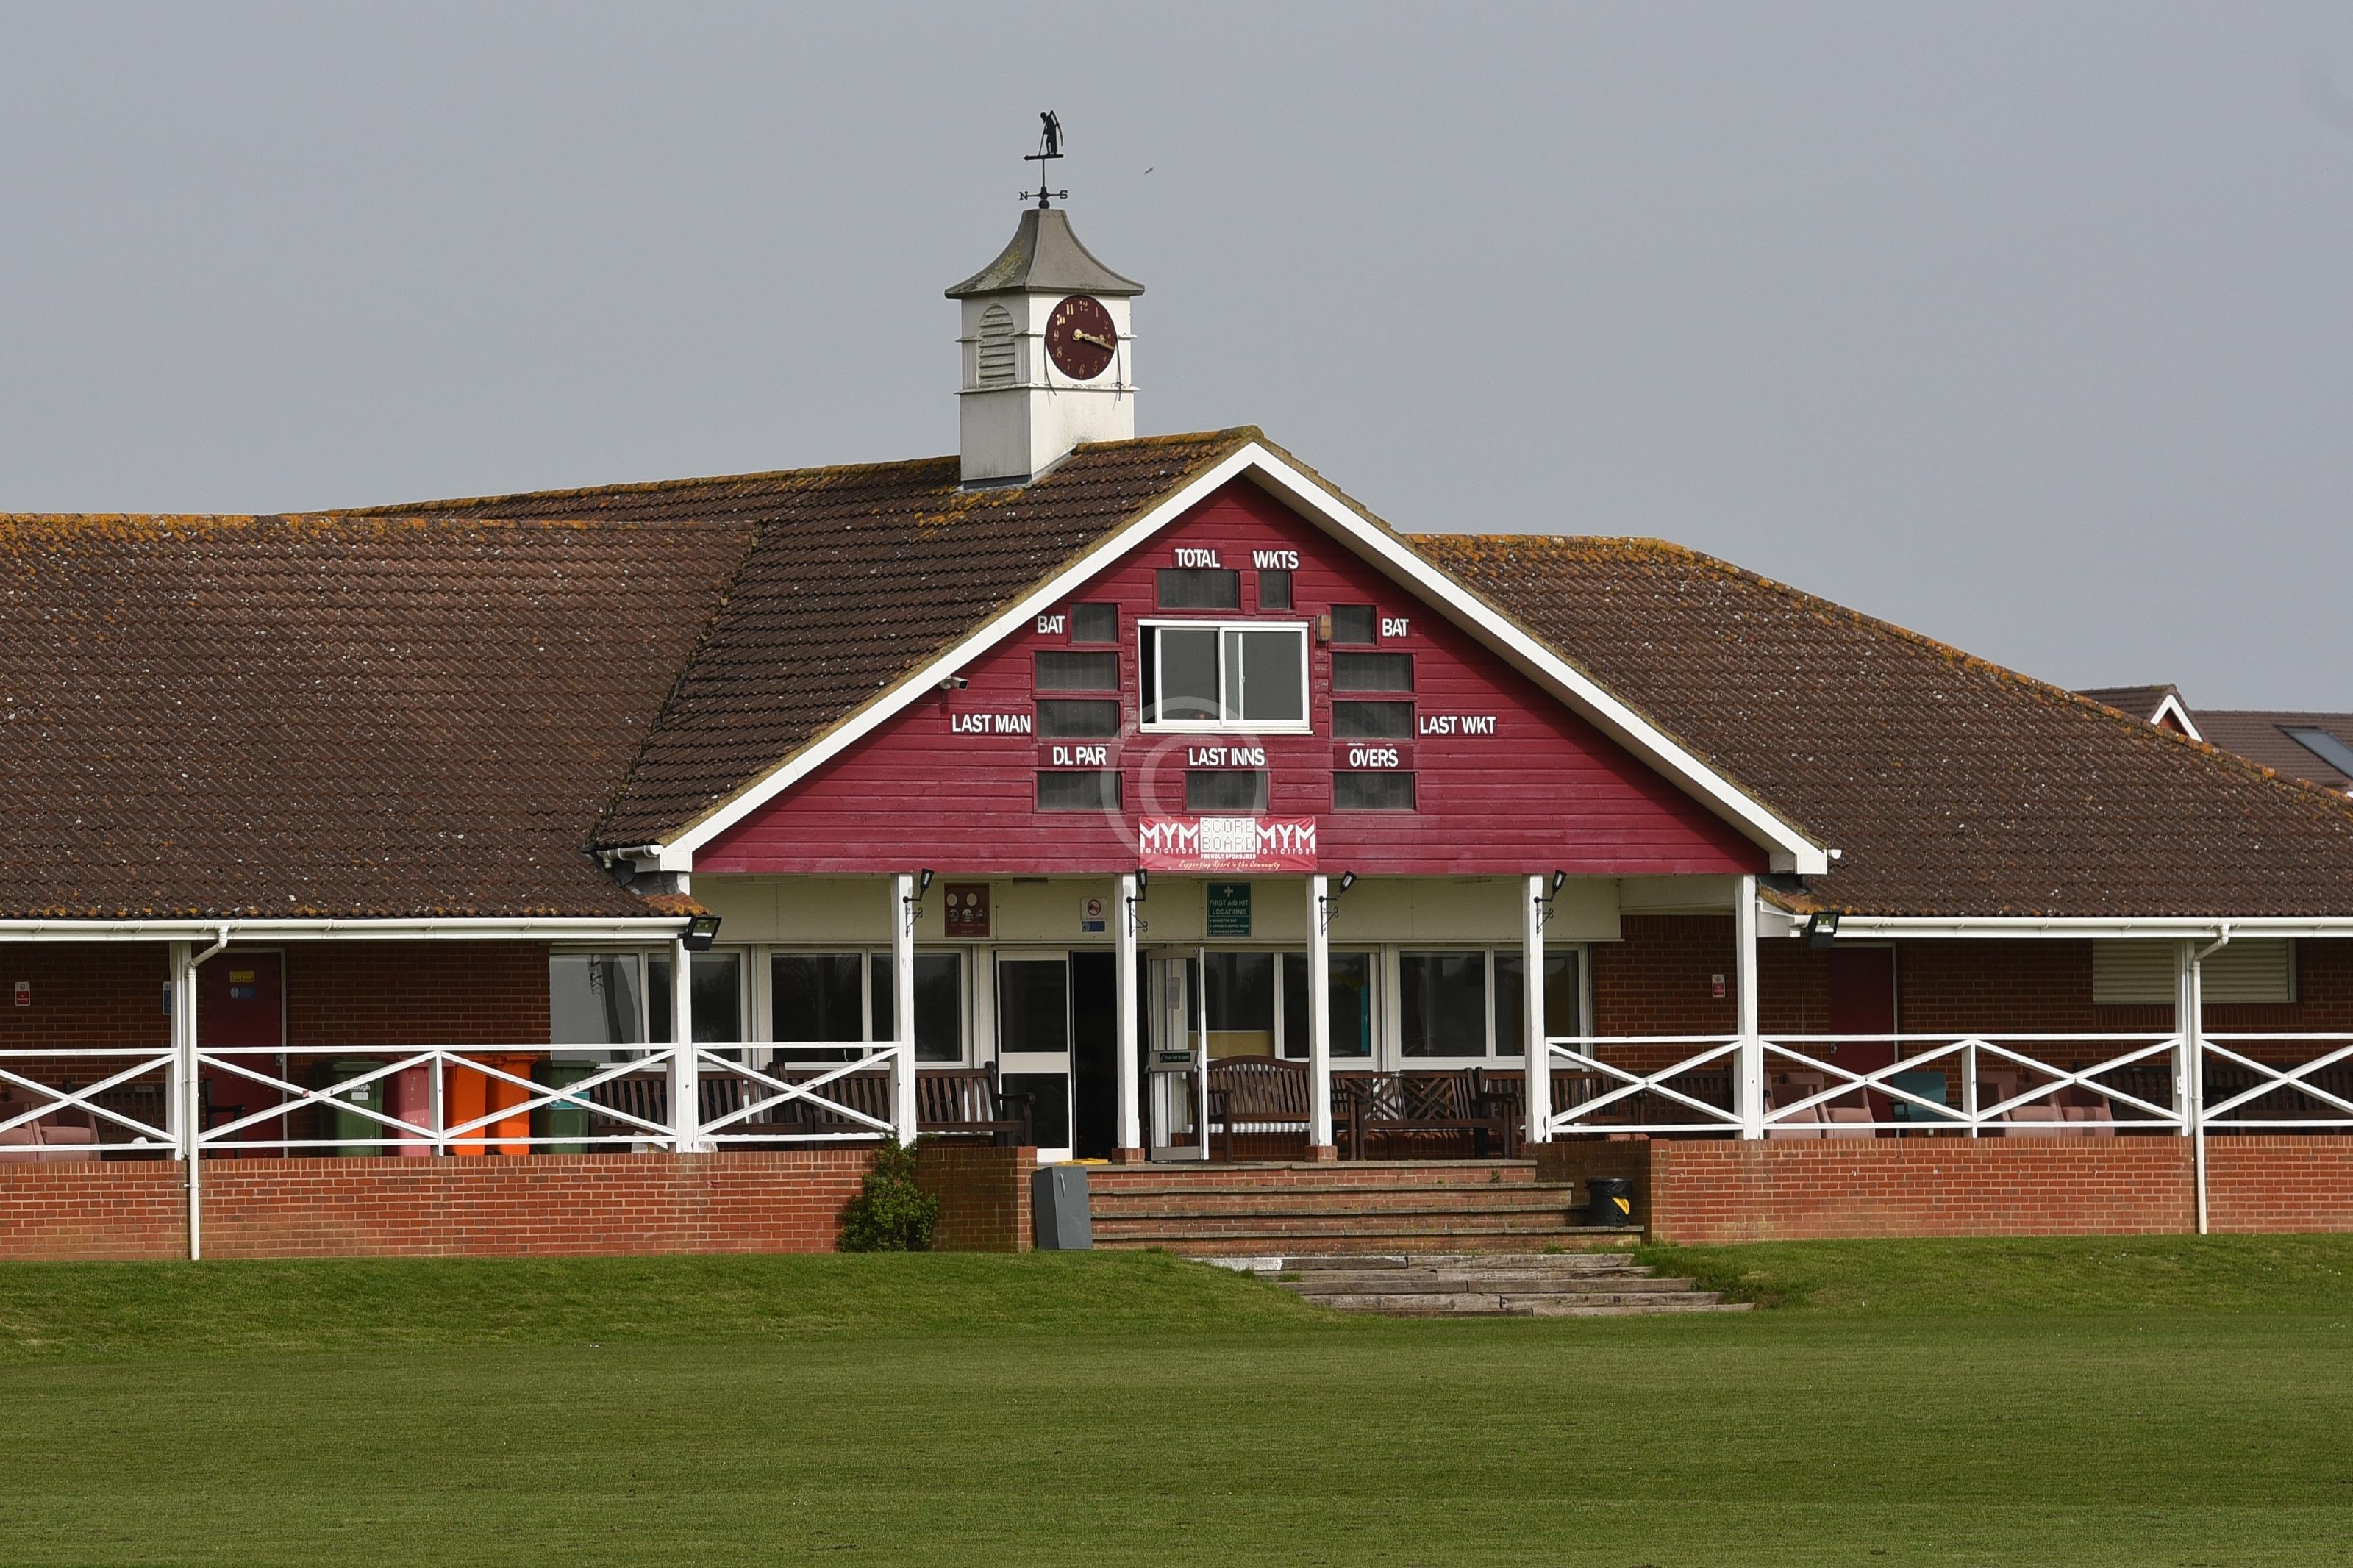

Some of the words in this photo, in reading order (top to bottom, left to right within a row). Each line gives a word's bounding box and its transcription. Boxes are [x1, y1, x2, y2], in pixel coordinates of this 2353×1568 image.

[1019, 190, 1028, 201] N
[1060, 190, 1068, 200] S
[1066, 304, 1074, 315] 11
[1079, 300, 1089, 312] 12
[1095, 307, 1099, 318] 1
[1056, 313, 1065, 326] 10
[1053, 329, 1060, 341] 9
[1056, 346, 1063, 358] 8
[1066, 358, 1072, 370] 7
[1079, 363, 1085, 376] 6
[1093, 360, 1099, 372] 5
[1175, 549, 1220, 568] TOTAL
[1253, 551, 1299, 569] WKTS
[1038, 616, 1065, 634] BAT
[1382, 618, 1409, 637] BAT
[952, 714, 992, 733] LAST
[995, 715, 1031, 734] MAN
[1420, 716, 1457, 734] LAST
[1461, 716, 1496, 734] WKT
[1053, 747, 1074, 765] DL
[1076, 747, 1107, 765] PAR
[1189, 748, 1227, 766] LAST
[1231, 748, 1265, 766] INNS
[1349, 748, 1399, 767] OVERS
[1202, 819, 1254, 834] SCORE
[1140, 823, 1199, 848] MYM
[1256, 823, 1315, 849] MYM
[1202, 837, 1254, 851] BOARD
[1179, 859, 1211, 870] Supporting
[1213, 859, 1230, 870] Sport
